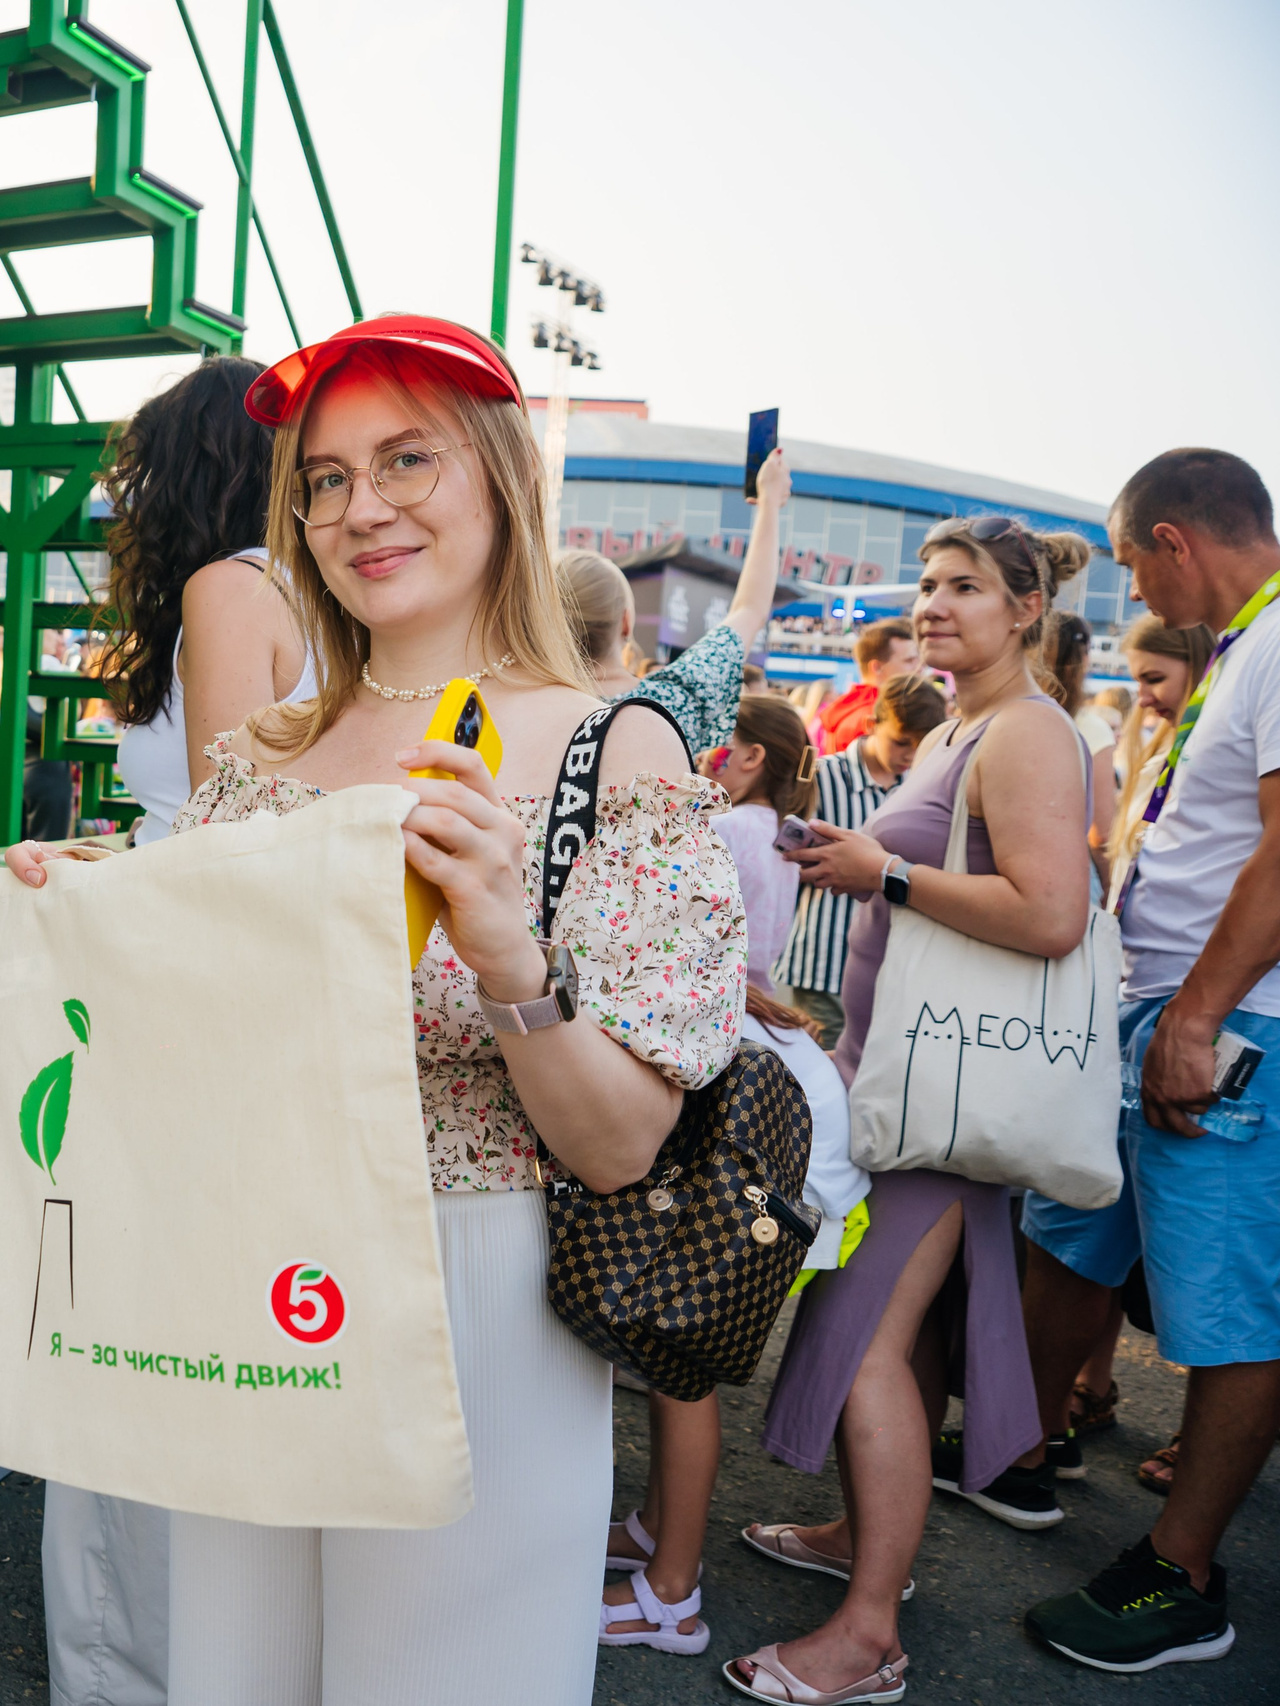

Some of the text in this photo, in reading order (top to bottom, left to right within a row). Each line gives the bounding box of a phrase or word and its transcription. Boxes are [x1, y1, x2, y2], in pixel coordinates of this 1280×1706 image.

[50, 1331, 62, 1357] Я
[91, 1343, 118, 1367] за
[124, 1350, 225, 1383] чистый
[234, 1361, 342, 1390] движ!
